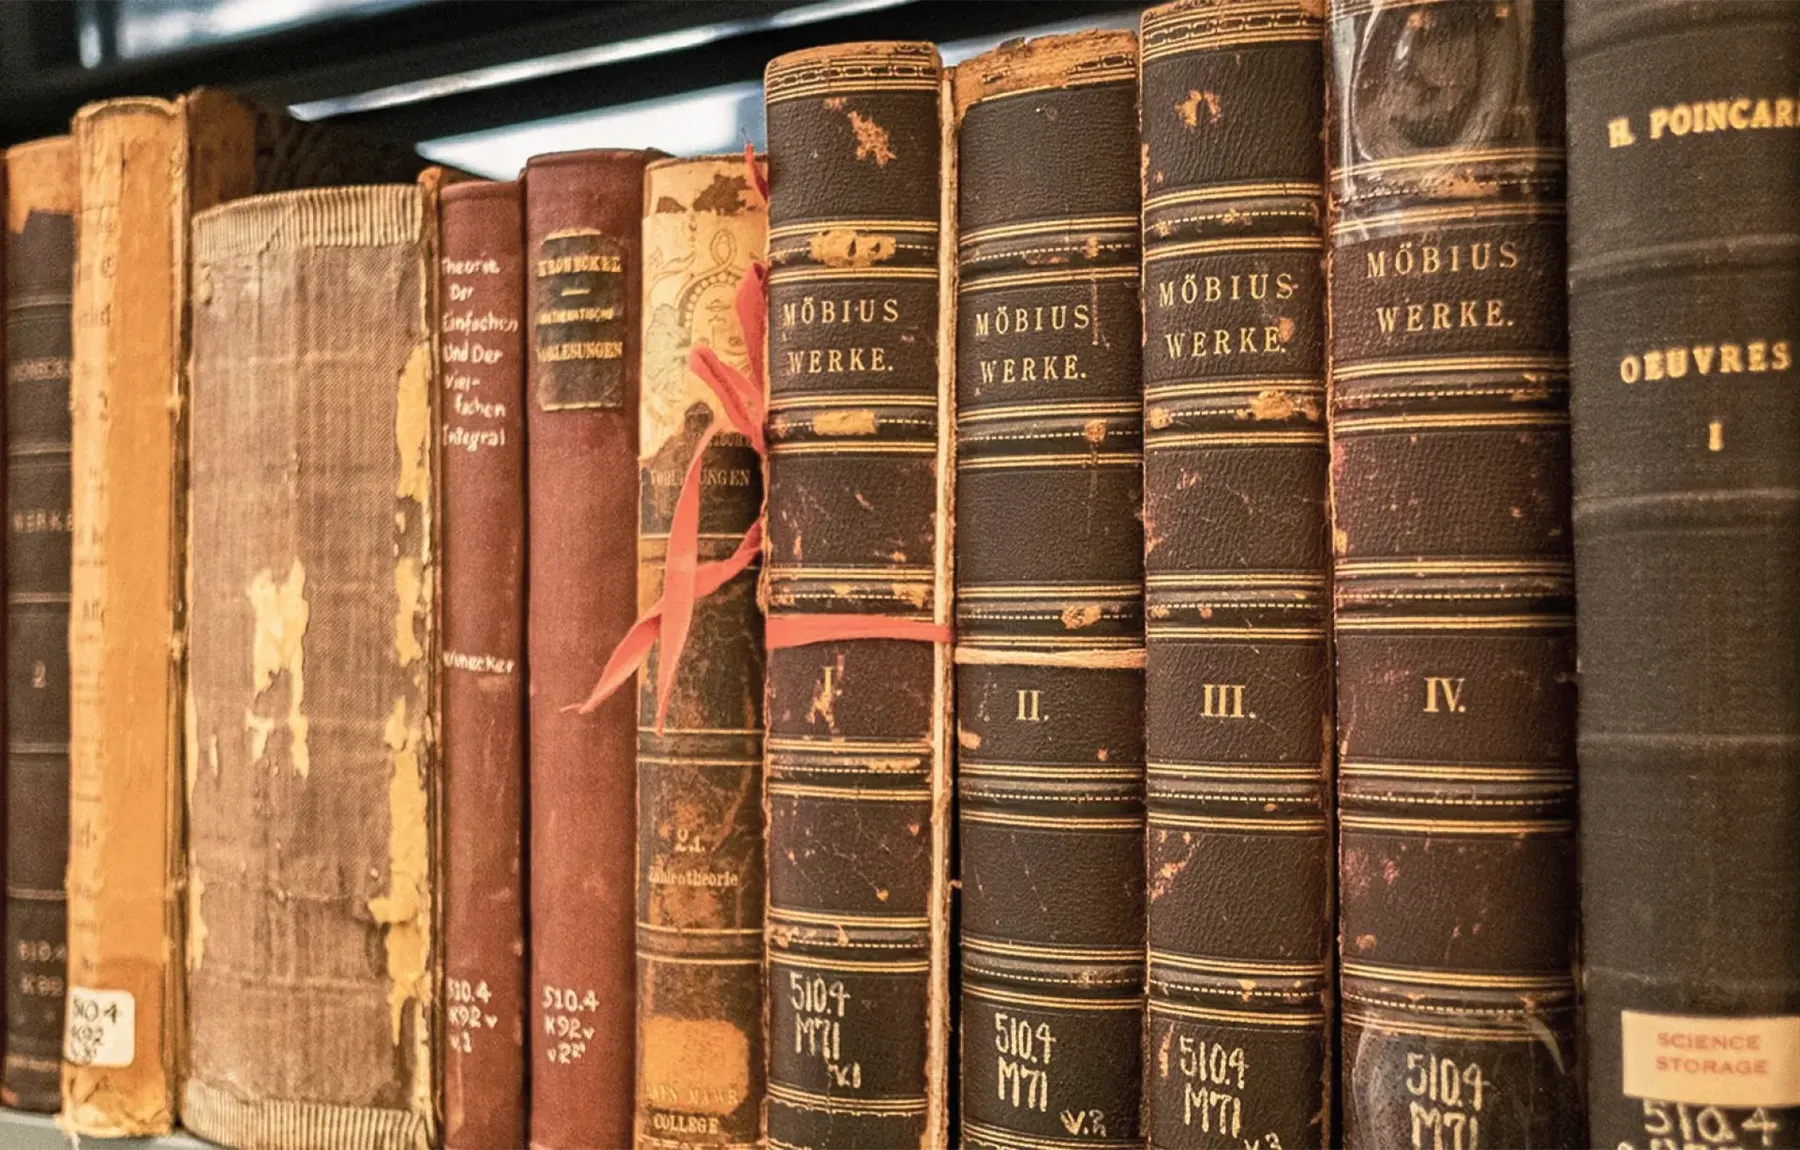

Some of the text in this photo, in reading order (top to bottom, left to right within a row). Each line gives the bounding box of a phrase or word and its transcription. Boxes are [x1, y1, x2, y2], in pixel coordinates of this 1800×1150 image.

[1366, 241, 1519, 279] MÖBIUS
[1159, 273, 1293, 308] MÖBIUS
[783, 296, 899, 327] MÖBIUS
[975, 305, 1090, 337] MÖBIUS
[1376, 299, 1515, 334] WERKE.
[1165, 326, 1287, 360] WERKE.
[788, 347, 894, 375] WERKE.
[980, 354, 1088, 384] WERKE.
[1620, 341, 1792, 385] OEUVRES
[1016, 689, 1050, 722] II.
[1201, 684, 1256, 718] III.
[1423, 677, 1466, 713] IV.
[541, 986, 600, 1013] 510.4
[795, 1012, 840, 1061] M71
[995, 1012, 1057, 1065] 510.4
[1656, 1032, 1761, 1050] SCIENCE
[1179, 1034, 1250, 1090] 510.4
[1655, 1055, 1769, 1075] STORAGE
[998, 1056, 1048, 1113] M71
[1406, 1052, 1494, 1112] 510.4
[652, 1113, 719, 1135] COLLEGE
[1183, 1083, 1242, 1139] M71
[1410, 1101, 1479, 1150] M71
